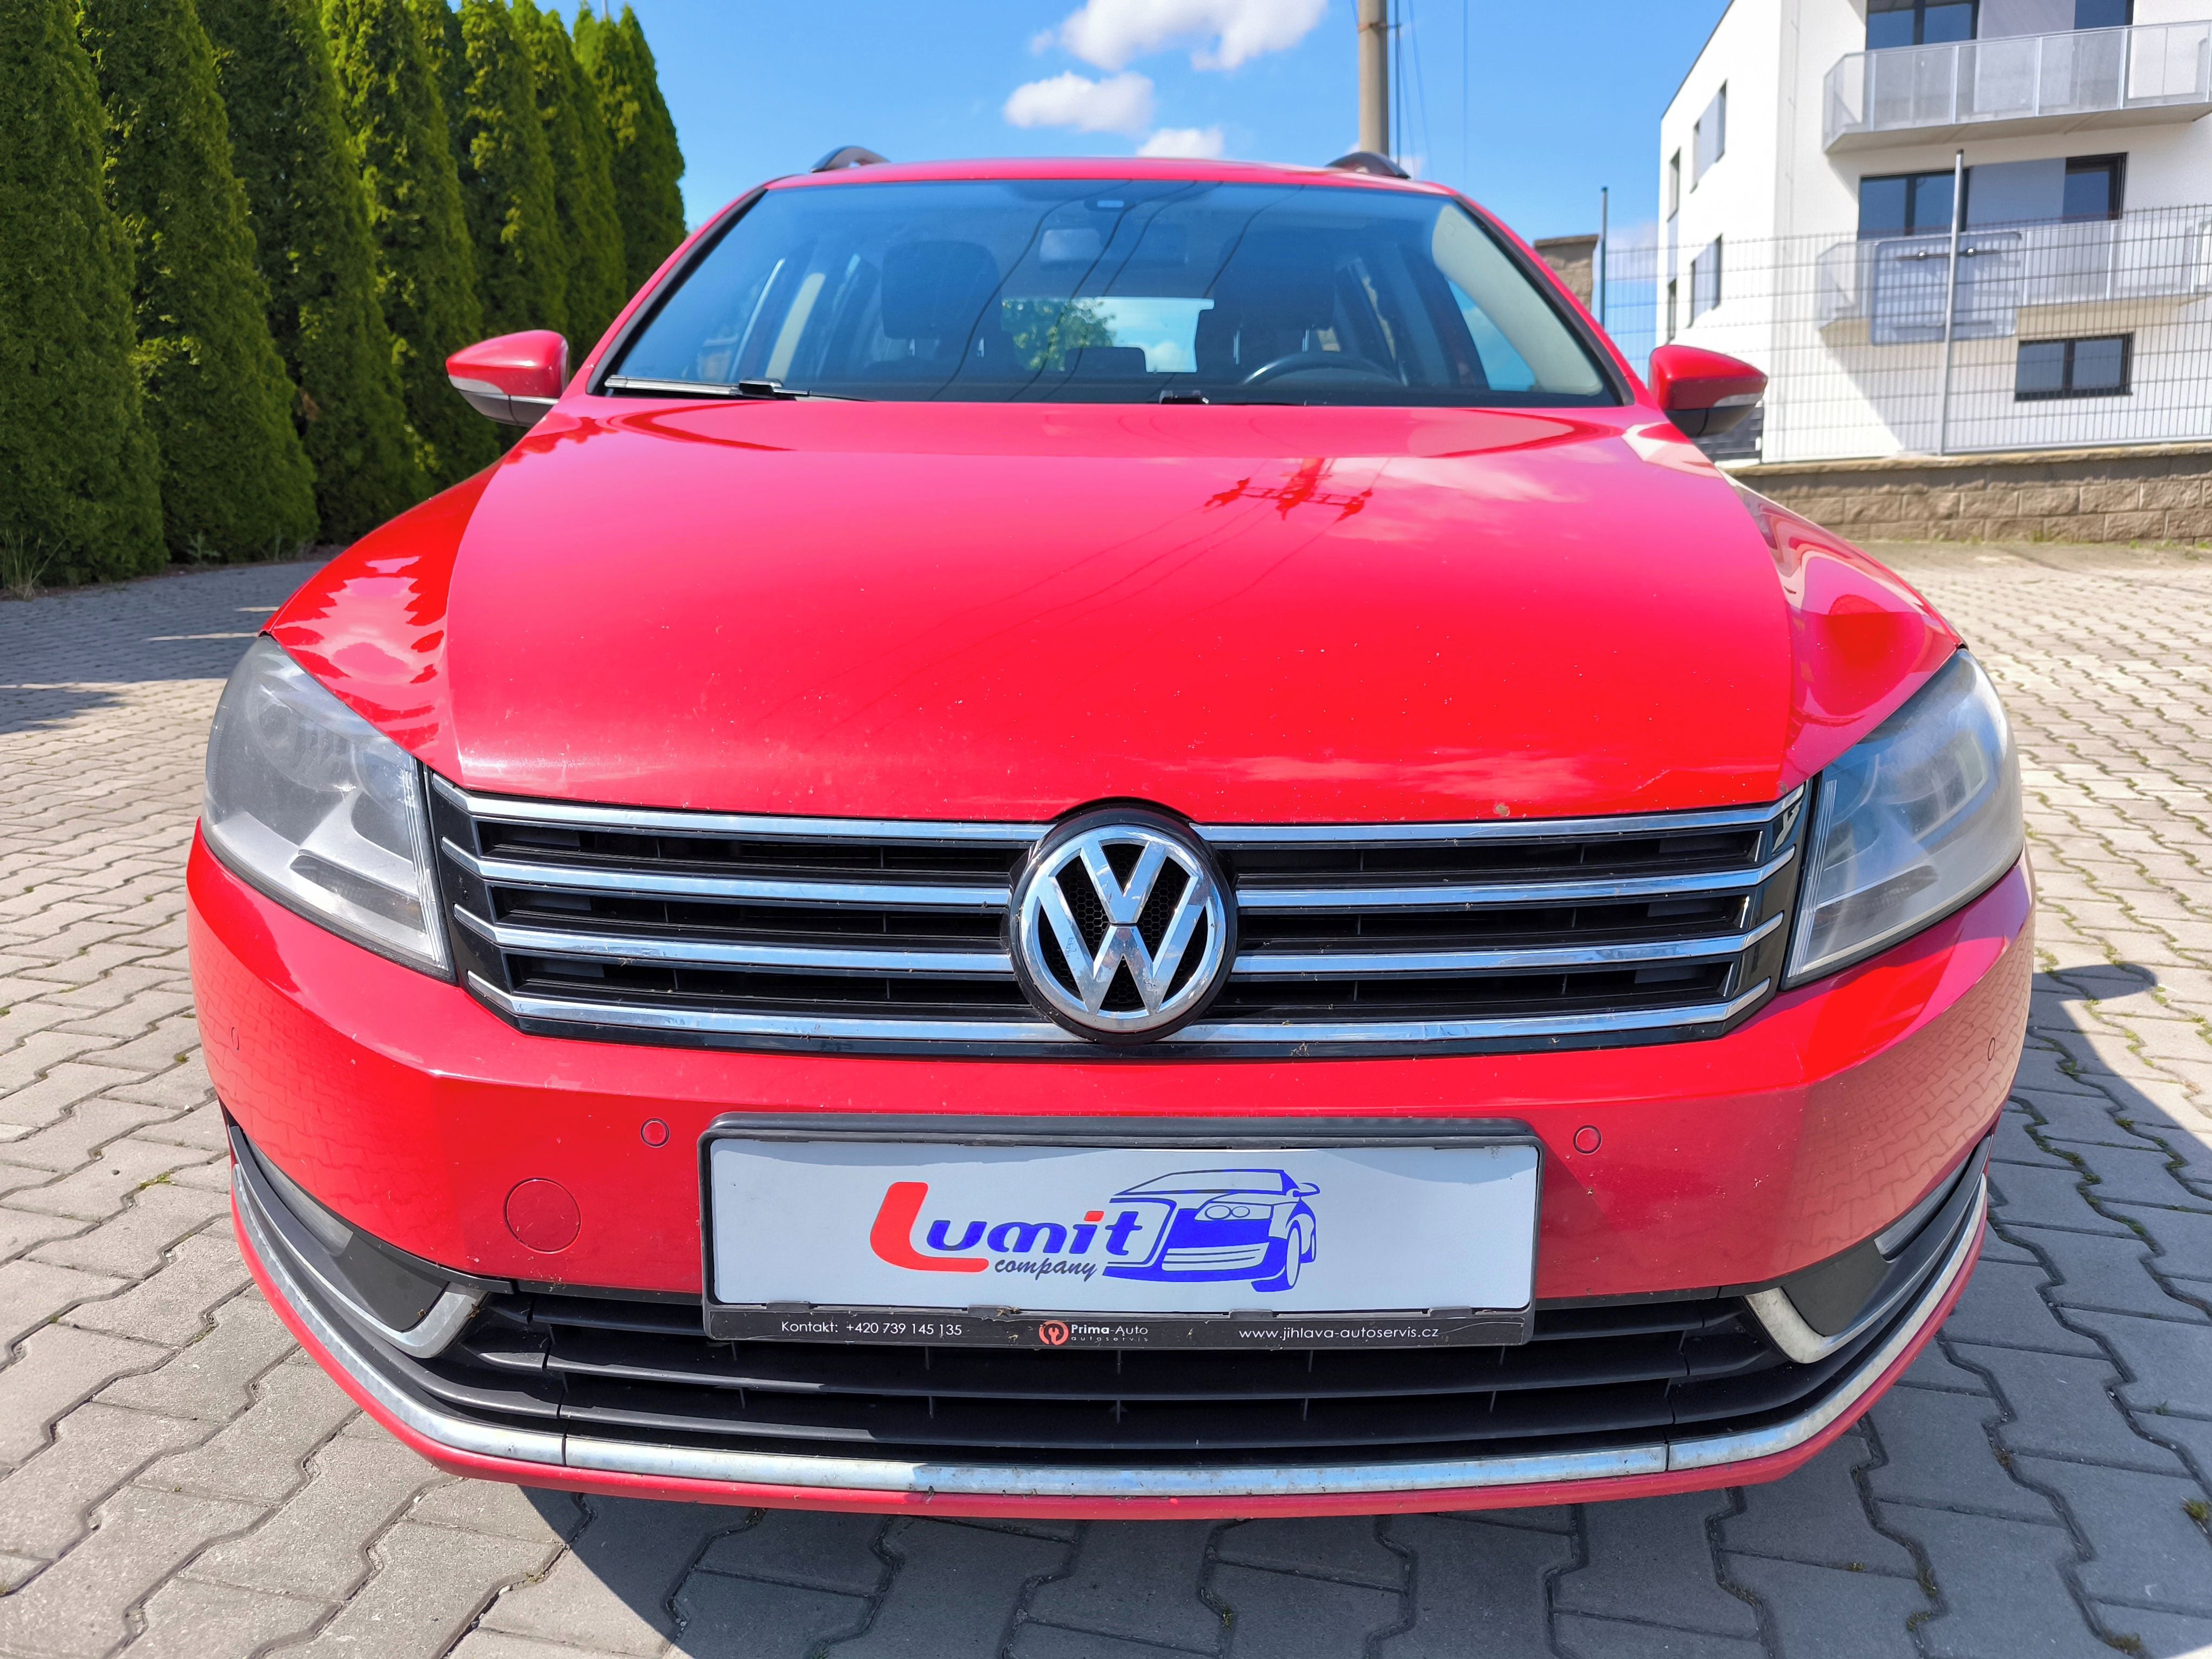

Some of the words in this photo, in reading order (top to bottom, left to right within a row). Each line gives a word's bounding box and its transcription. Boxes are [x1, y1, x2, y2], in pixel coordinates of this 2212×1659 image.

[870, 1182, 1143, 1272] Lumit
[994, 1258, 1097, 1282] company
[781, 1321, 838, 1333] Kontakt:
[846, 1323, 879, 1334] +420
[882, 1323, 906, 1334] 739
[912, 1324, 934, 1334] 145
[940, 1324, 962, 1336] 135
[1071, 1324, 1148, 1335] Prima-Auto
[1239, 1327, 1439, 1341] www.jihlava-autoservis.cz
